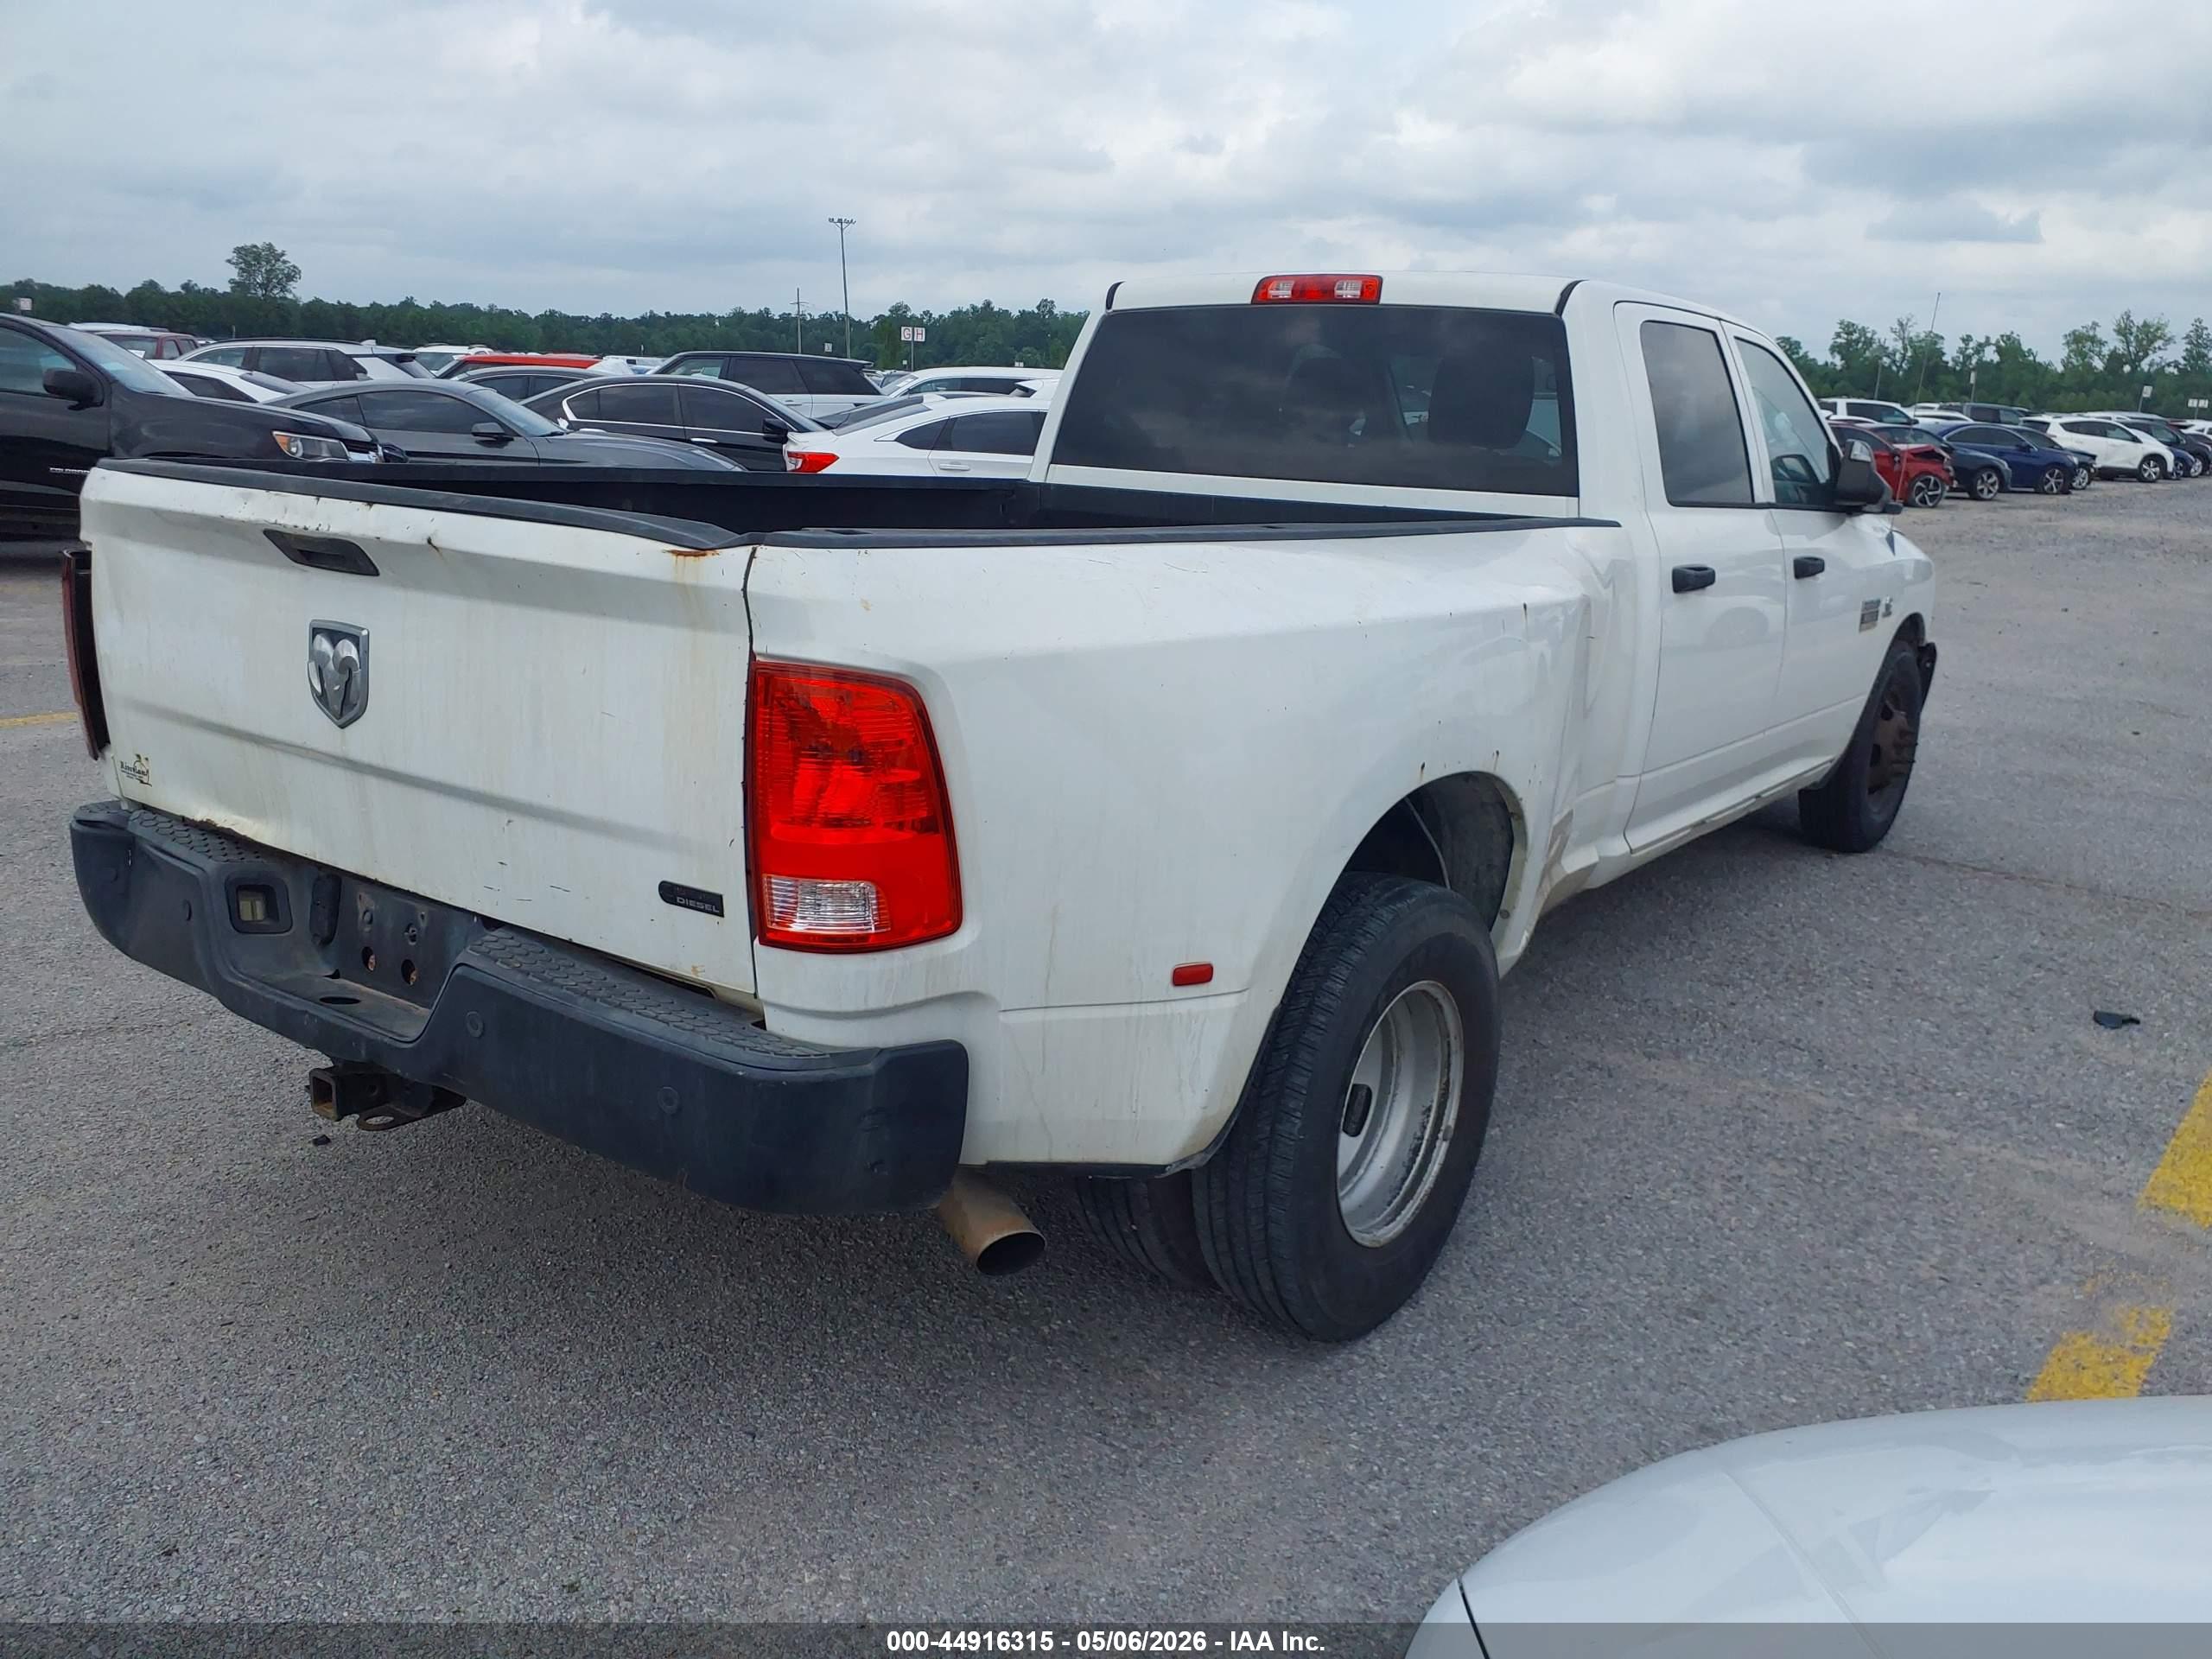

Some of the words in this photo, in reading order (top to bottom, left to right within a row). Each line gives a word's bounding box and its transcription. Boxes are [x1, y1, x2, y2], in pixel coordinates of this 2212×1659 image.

[903, 327, 912, 340] G
[916, 328, 924, 340] H
[677, 896, 720, 912] DIESEL
